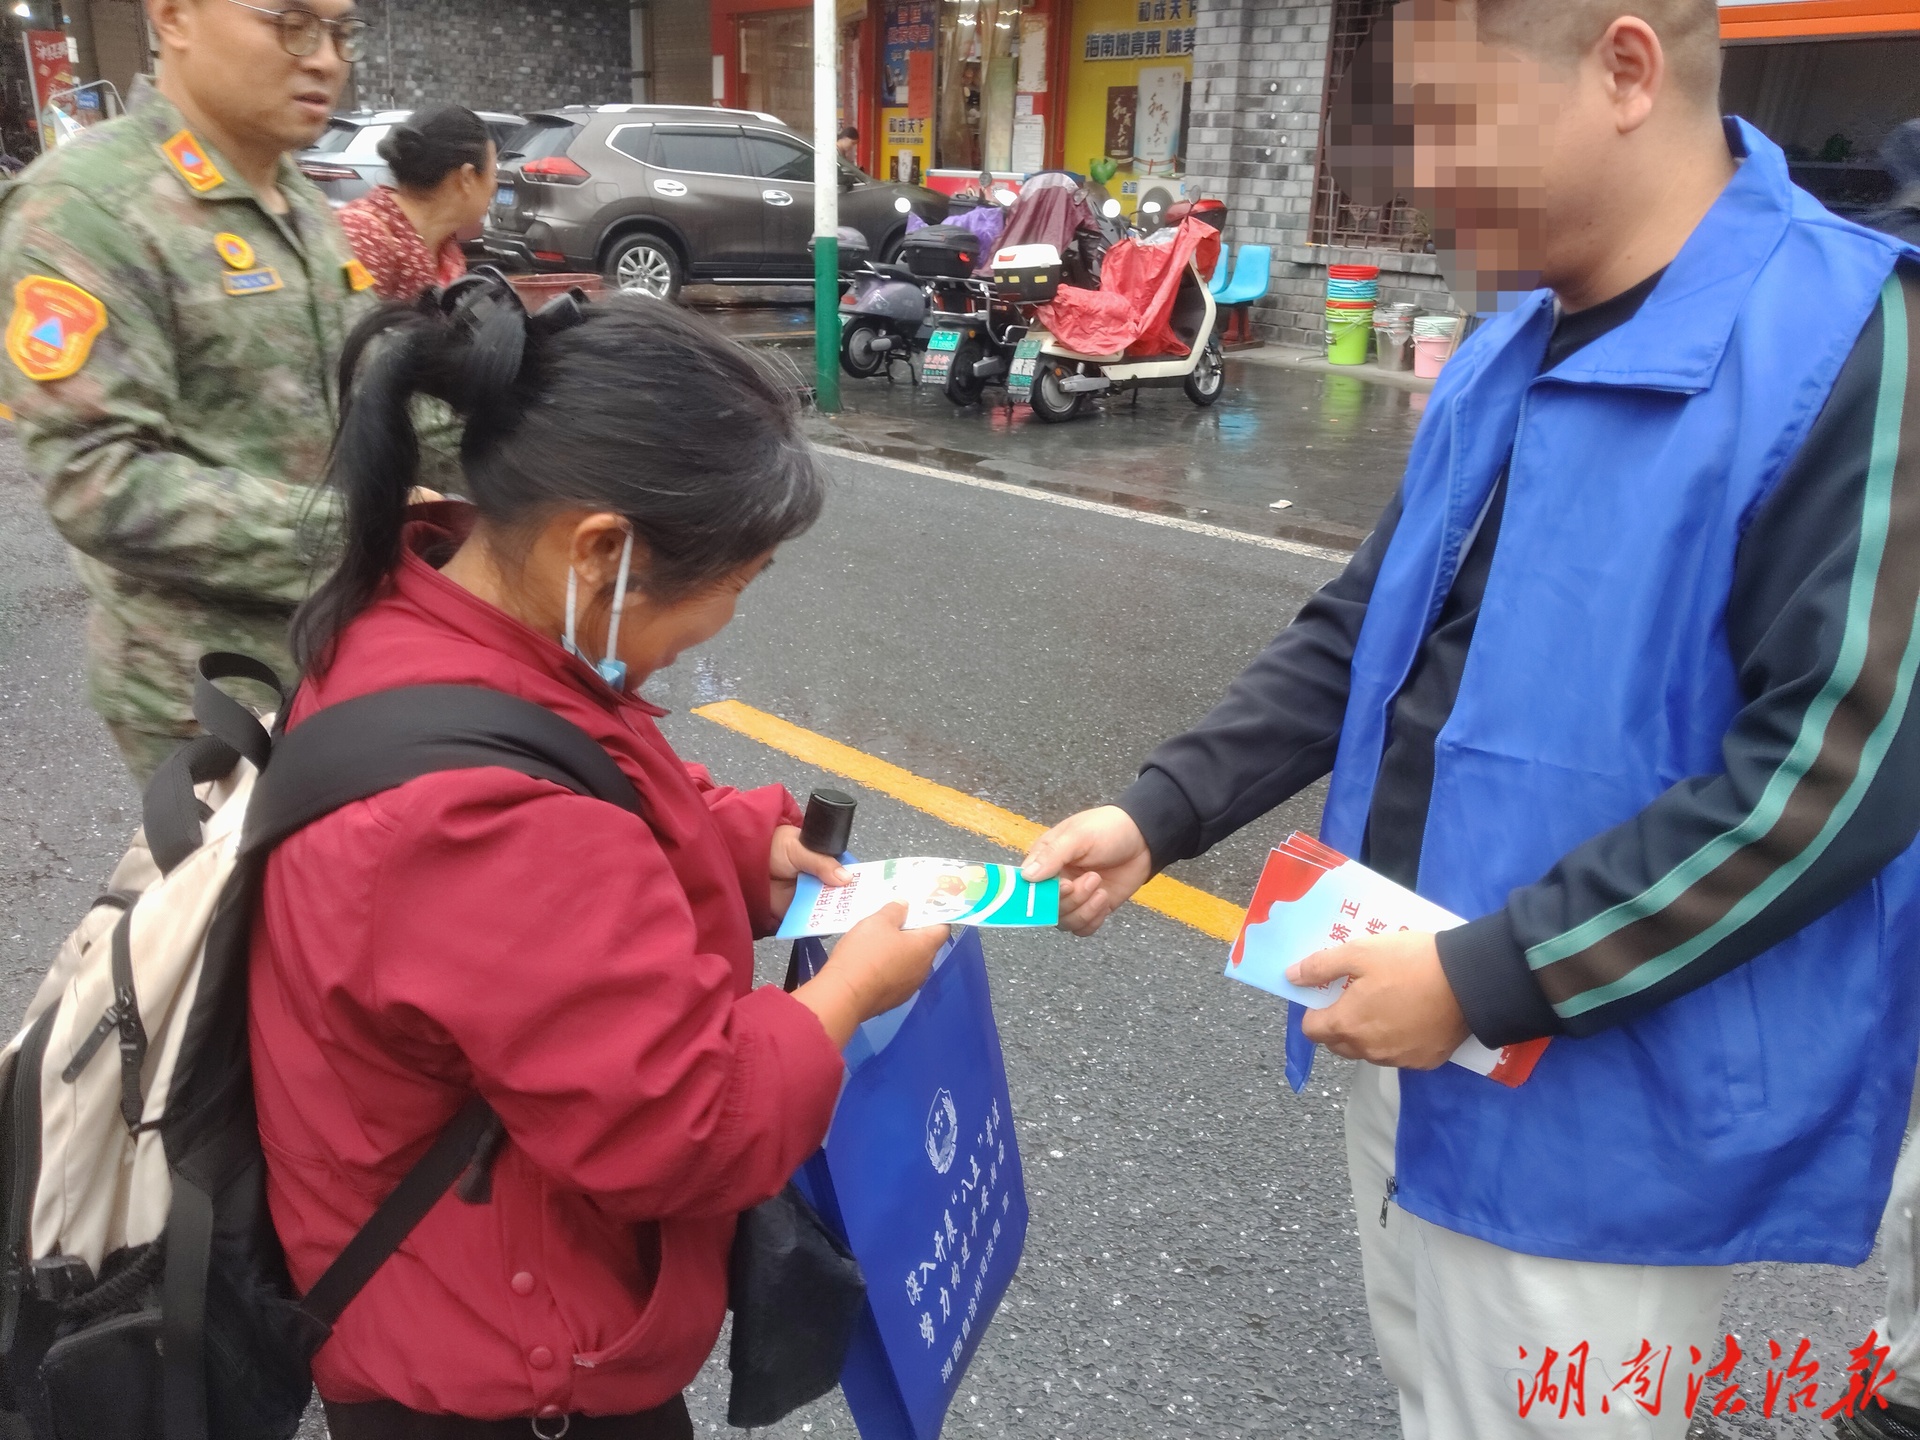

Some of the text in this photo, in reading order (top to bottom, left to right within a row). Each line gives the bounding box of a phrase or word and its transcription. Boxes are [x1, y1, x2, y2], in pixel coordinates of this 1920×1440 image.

[1085, 31, 1161, 59] 海南嫩青果
[941, 1218, 1001, 1384] 湘西自治州司法局
